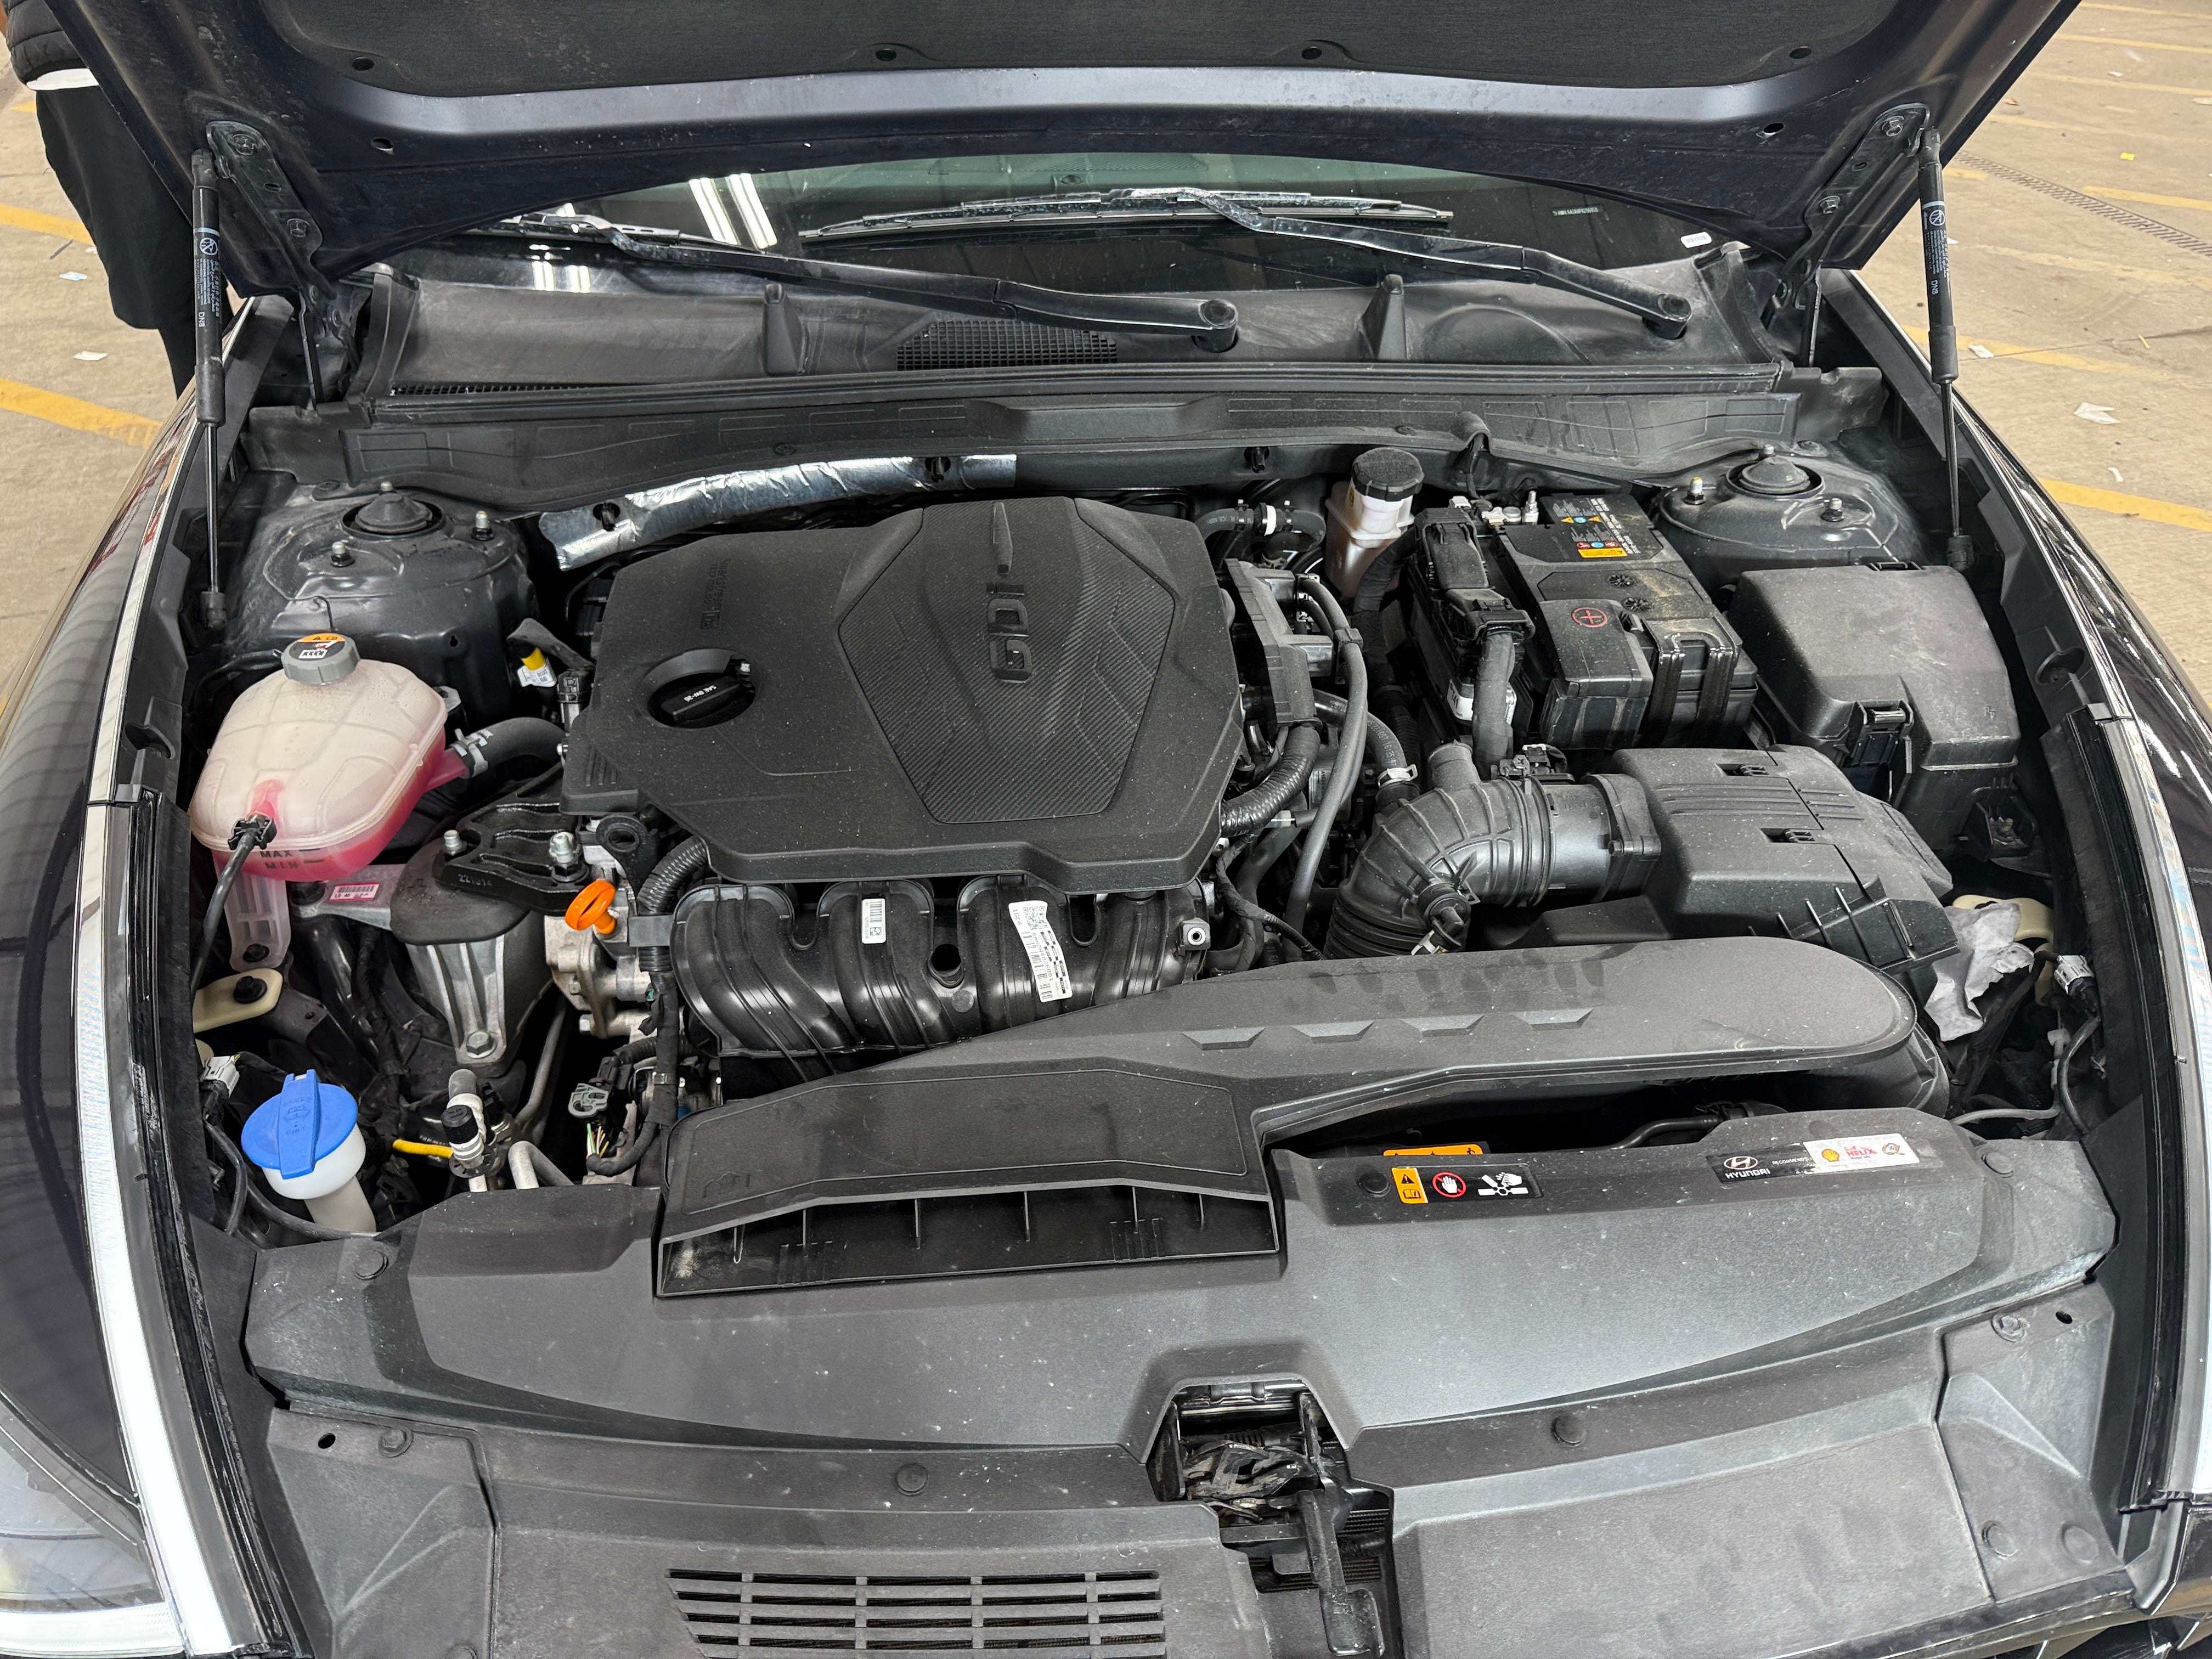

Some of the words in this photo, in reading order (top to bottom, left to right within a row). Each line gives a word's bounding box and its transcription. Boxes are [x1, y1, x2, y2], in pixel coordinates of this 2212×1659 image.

[987, 583, 1034, 683] GDI
[259, 850, 292, 859] MAX
[264, 861, 298, 870] MIN
[1846, 1149, 1877, 1157] HELIX
[1724, 1169, 1771, 1180] HYUNDAI
